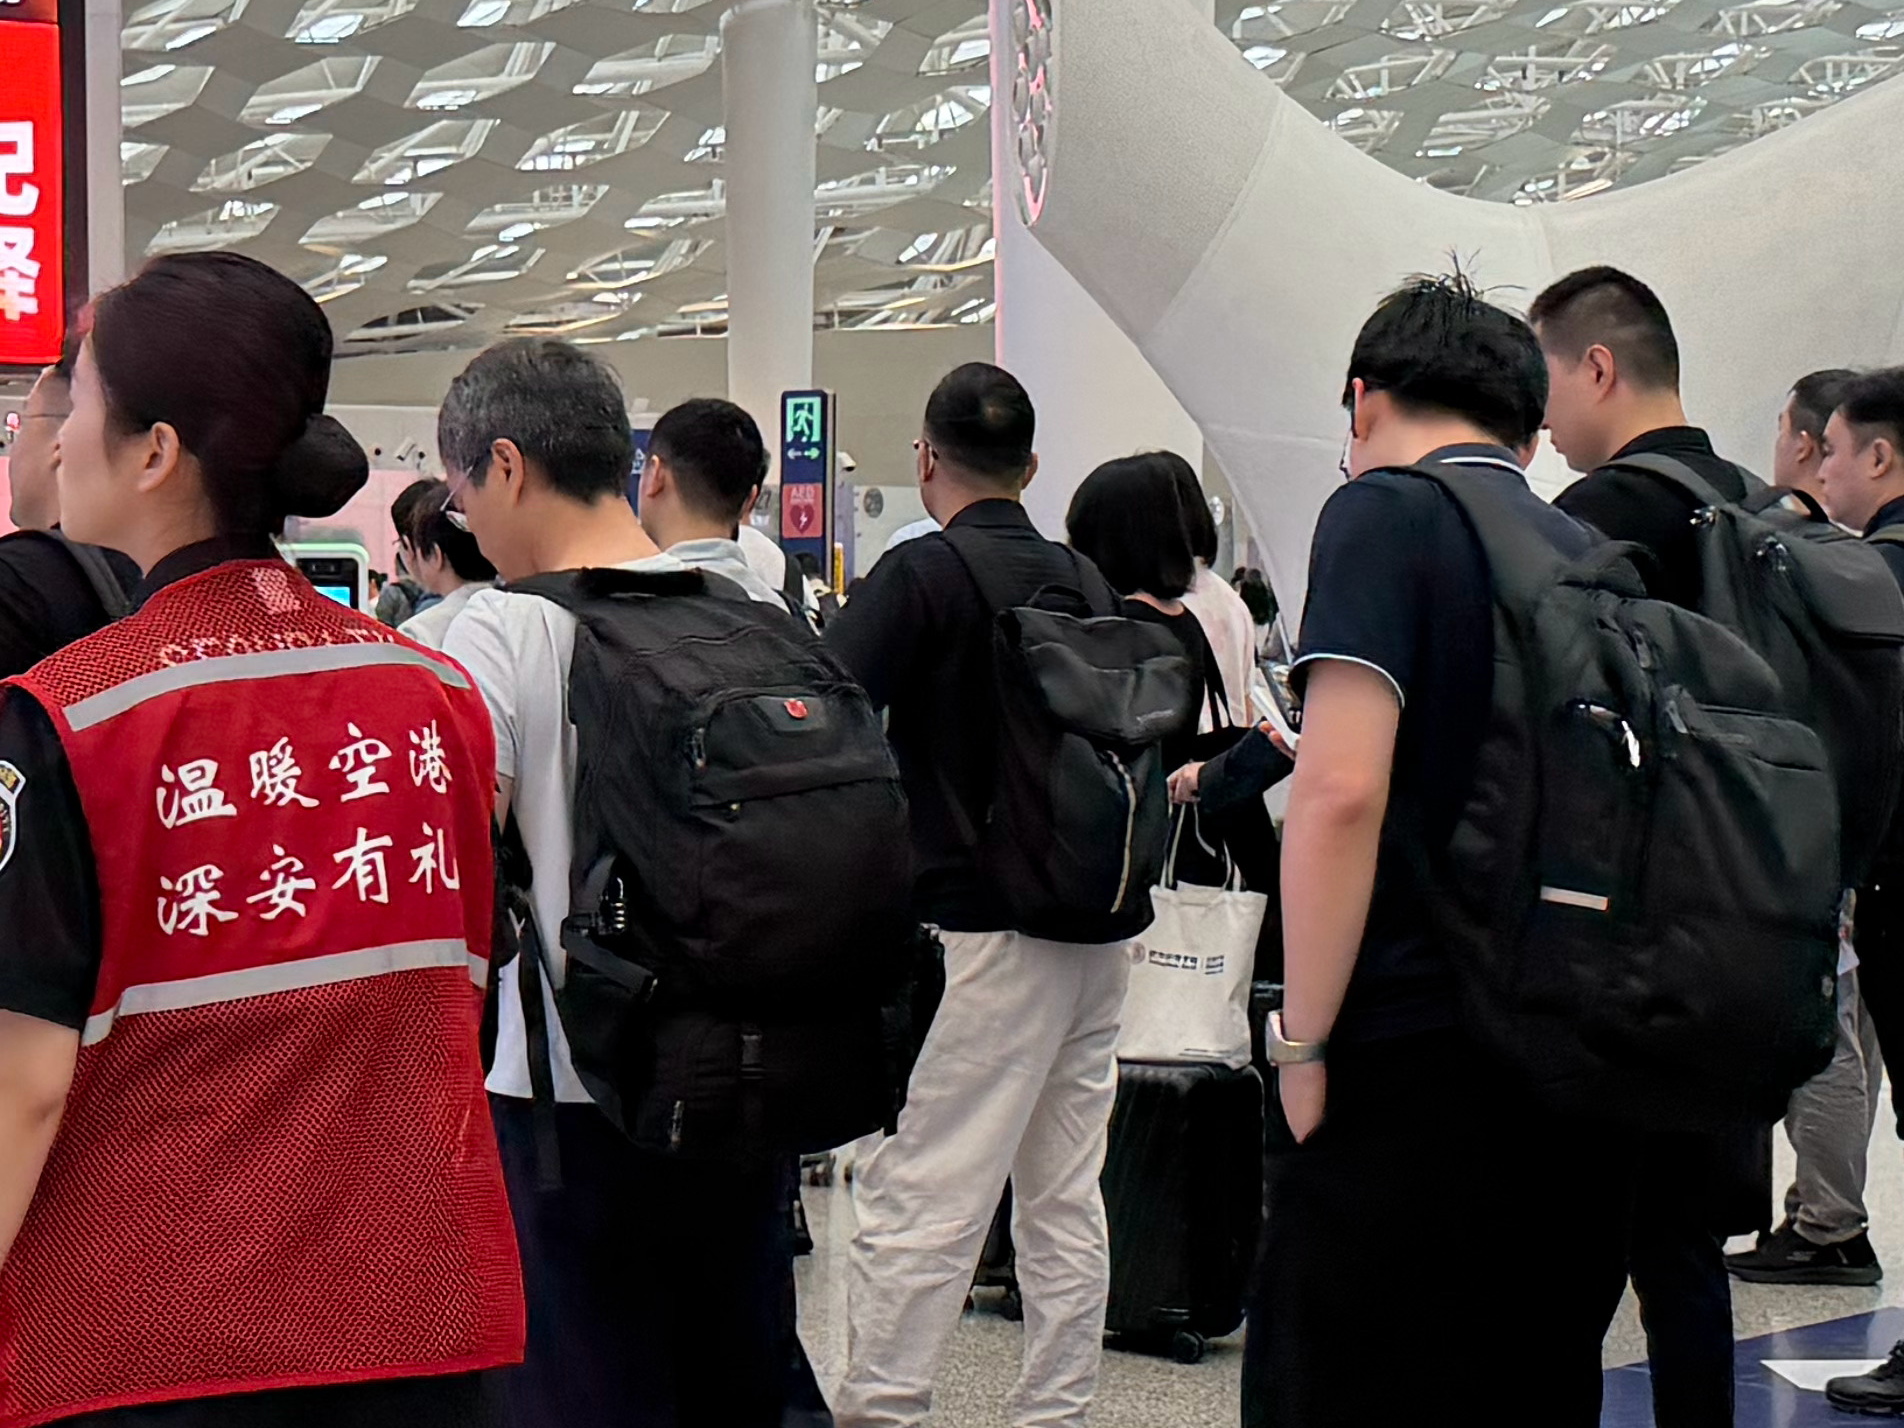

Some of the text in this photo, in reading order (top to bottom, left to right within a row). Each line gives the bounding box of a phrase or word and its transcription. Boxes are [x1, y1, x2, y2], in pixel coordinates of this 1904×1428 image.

[154, 718, 455, 830] 温暖空港
[156, 821, 461, 937] 深安有礼
